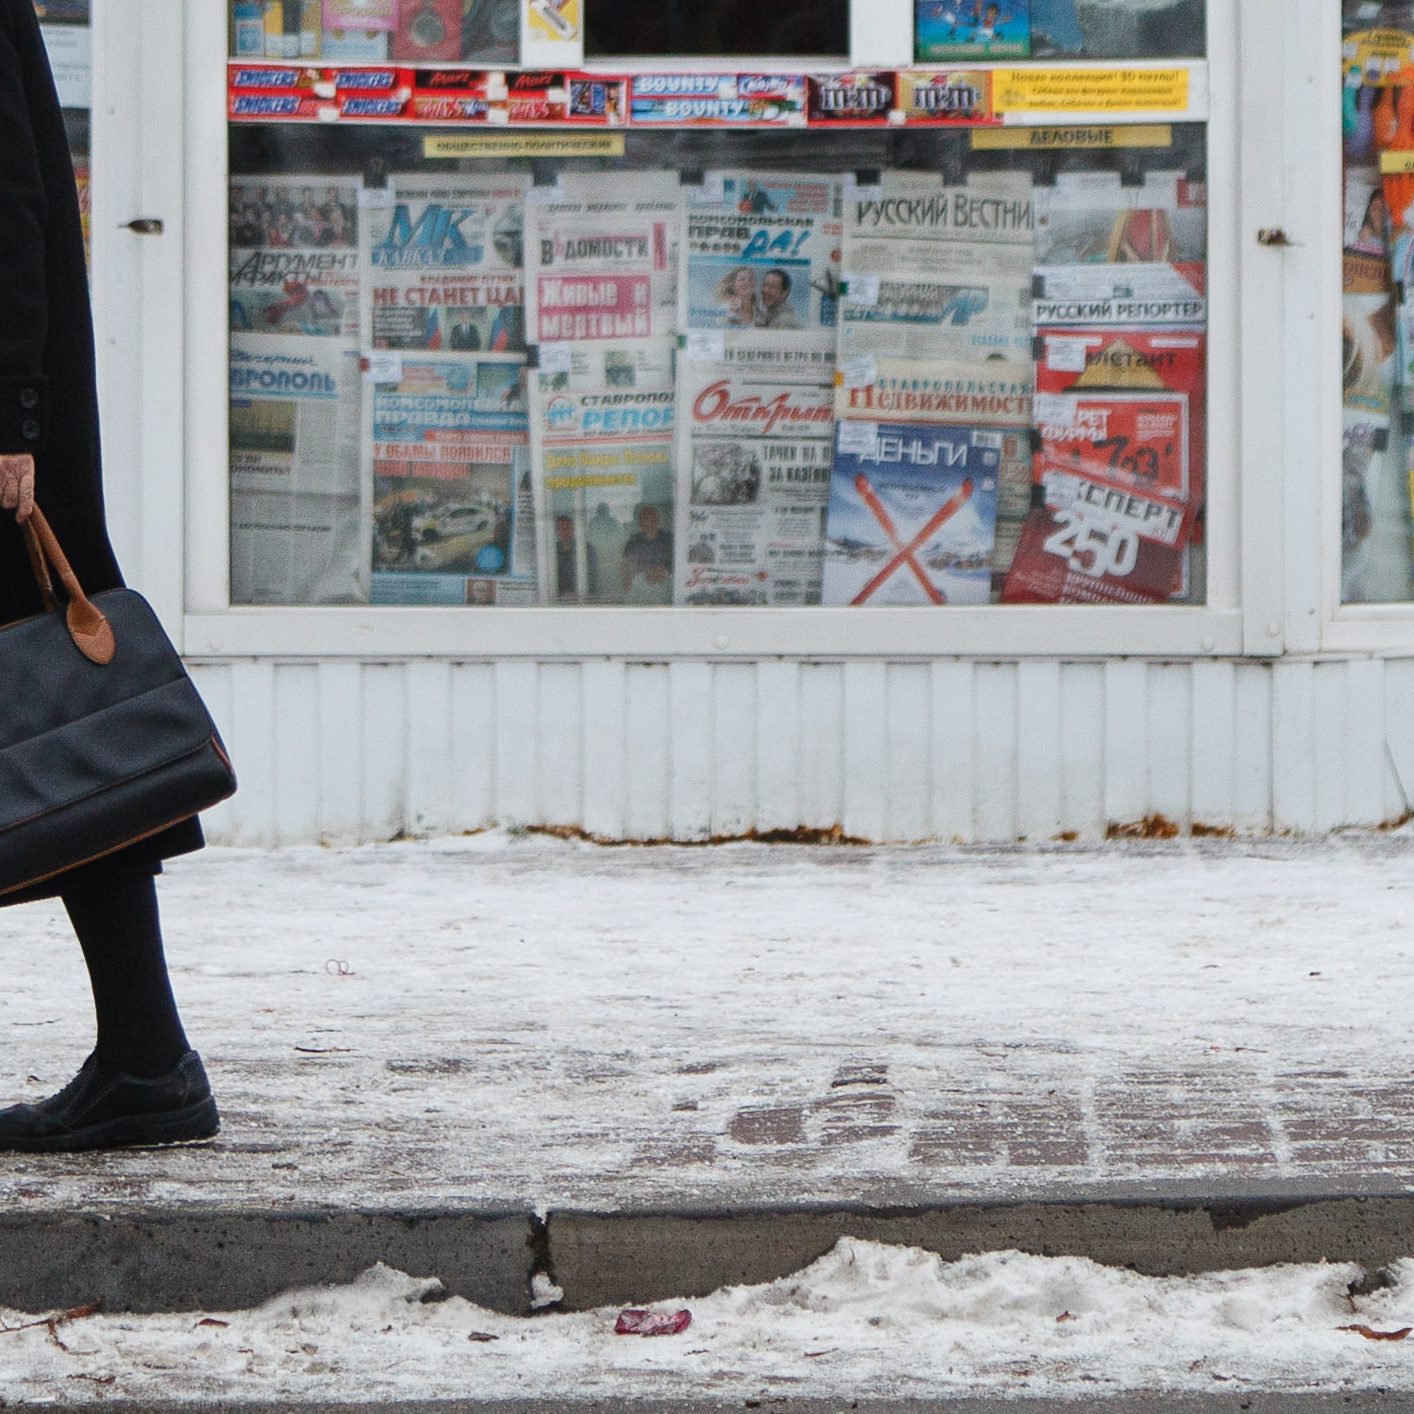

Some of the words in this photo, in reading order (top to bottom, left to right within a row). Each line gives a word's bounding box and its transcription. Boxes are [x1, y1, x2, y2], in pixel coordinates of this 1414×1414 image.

[1029, 129, 1114, 145] ДЕЛОВЫЕ
[380, 203, 474, 250] МК
[855, 197, 947, 228] РУССКИЙ
[372, 286, 401, 307] НЕ
[404, 286, 483, 307] СТАНЕТ
[1036, 304, 1111, 323] РУССКИЙ
[1116, 303, 1204, 323] РЕПОРТЕР
[859, 437, 968, 468] ДЕНЬГИ
[1043, 509, 1141, 579] 250
